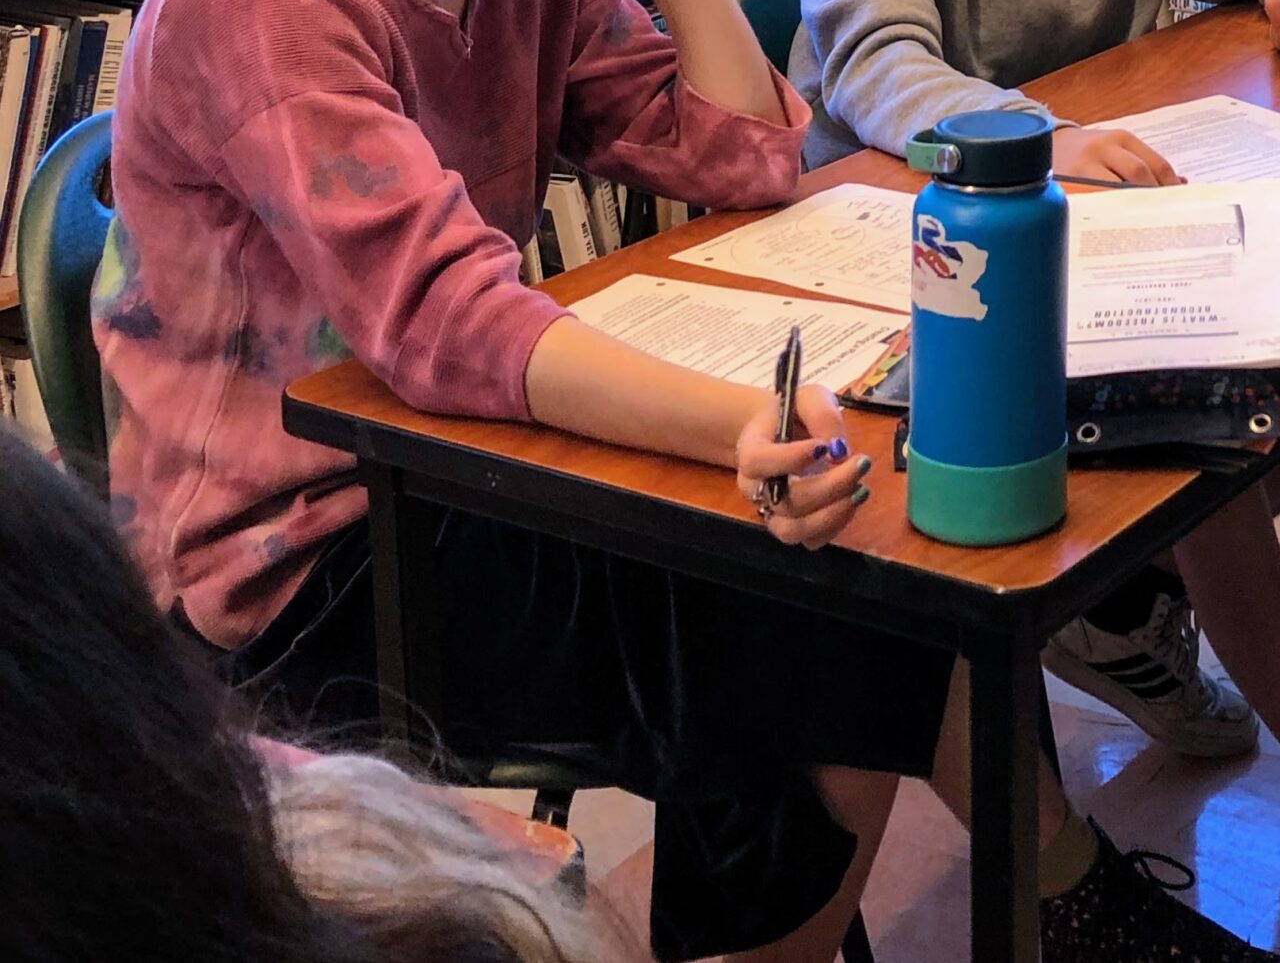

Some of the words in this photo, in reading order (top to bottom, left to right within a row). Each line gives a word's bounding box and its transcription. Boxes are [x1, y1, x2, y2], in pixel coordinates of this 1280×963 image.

[106, 40, 124, 56] THE
[100, 60, 120, 84] CIVIL
[96, 88, 115, 107] WAR
[1093, 305, 1211, 318] RECONSTRUCTION
[1162, 316, 1174, 325] IS
